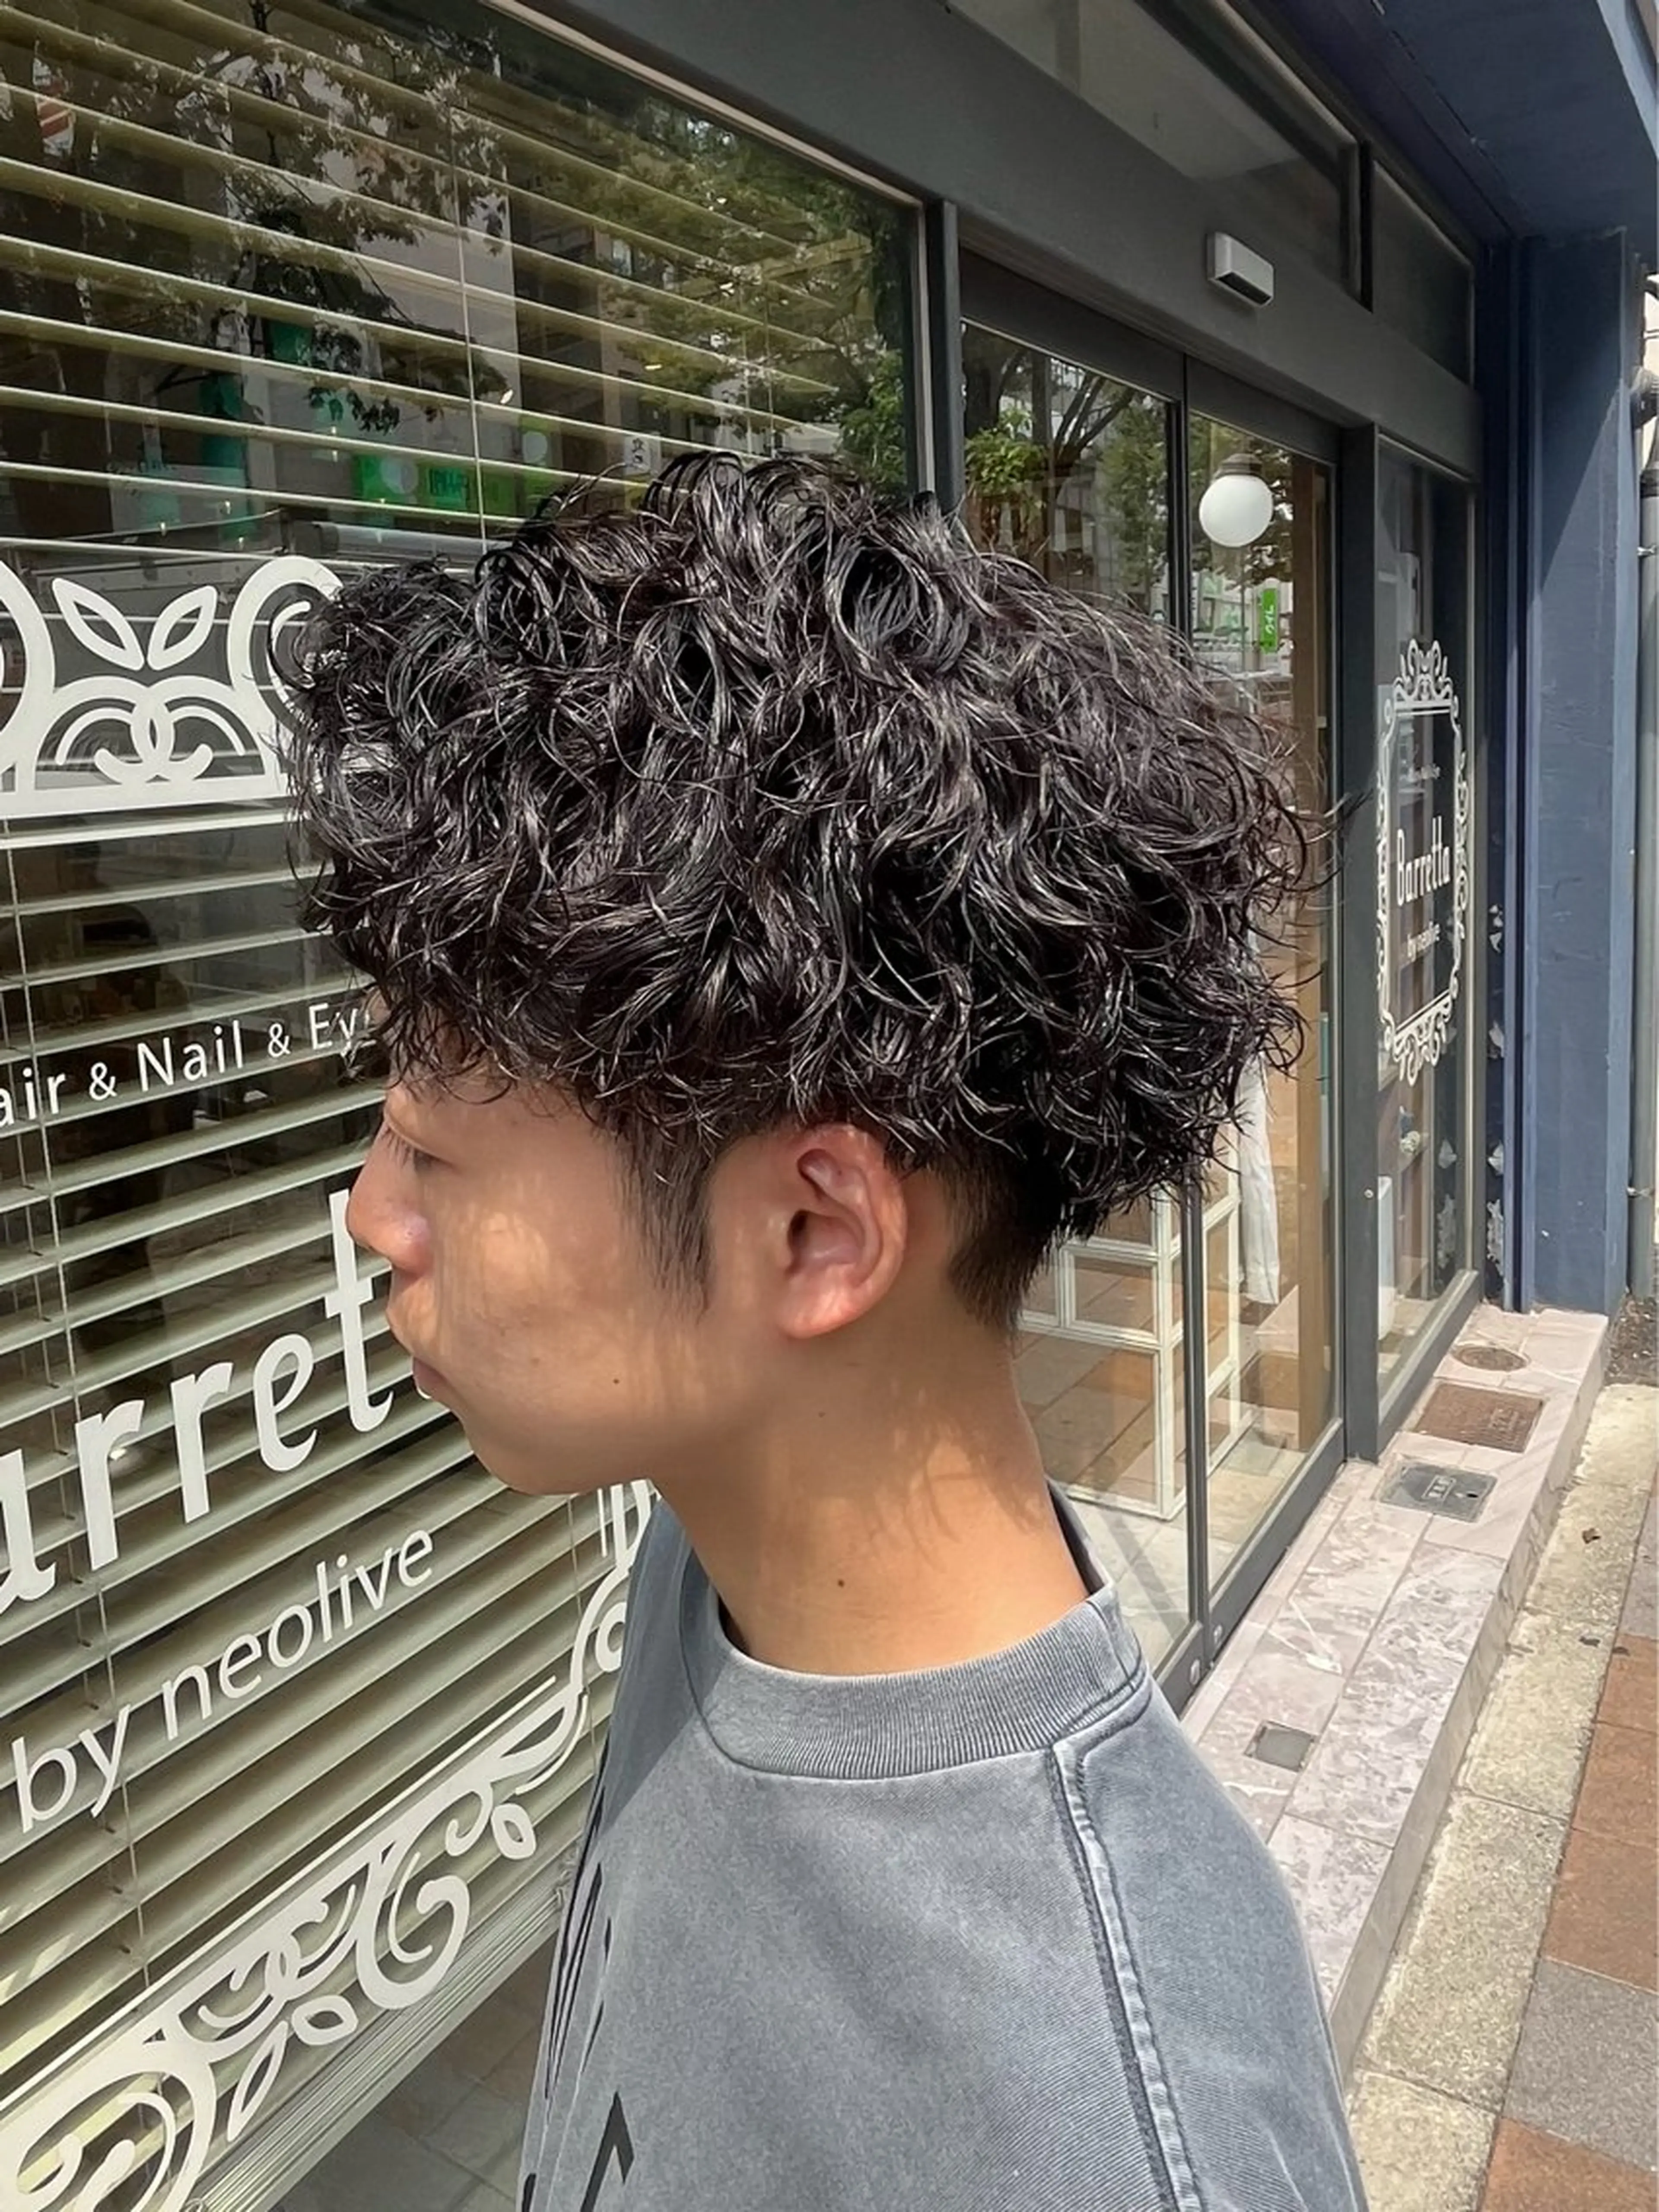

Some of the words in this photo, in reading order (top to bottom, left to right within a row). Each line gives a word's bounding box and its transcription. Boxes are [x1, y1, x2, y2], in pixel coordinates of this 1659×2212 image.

[1397, 815, 1450, 906] Barretta
[89, 1062, 118, 1101] &
[137, 1020, 243, 1092] Nail
[267, 1022, 291, 1058] &
[0, 1189, 432, 1616] arret
[11, 1703, 131, 1834] by
[162, 1528, 434, 1742] neolive
